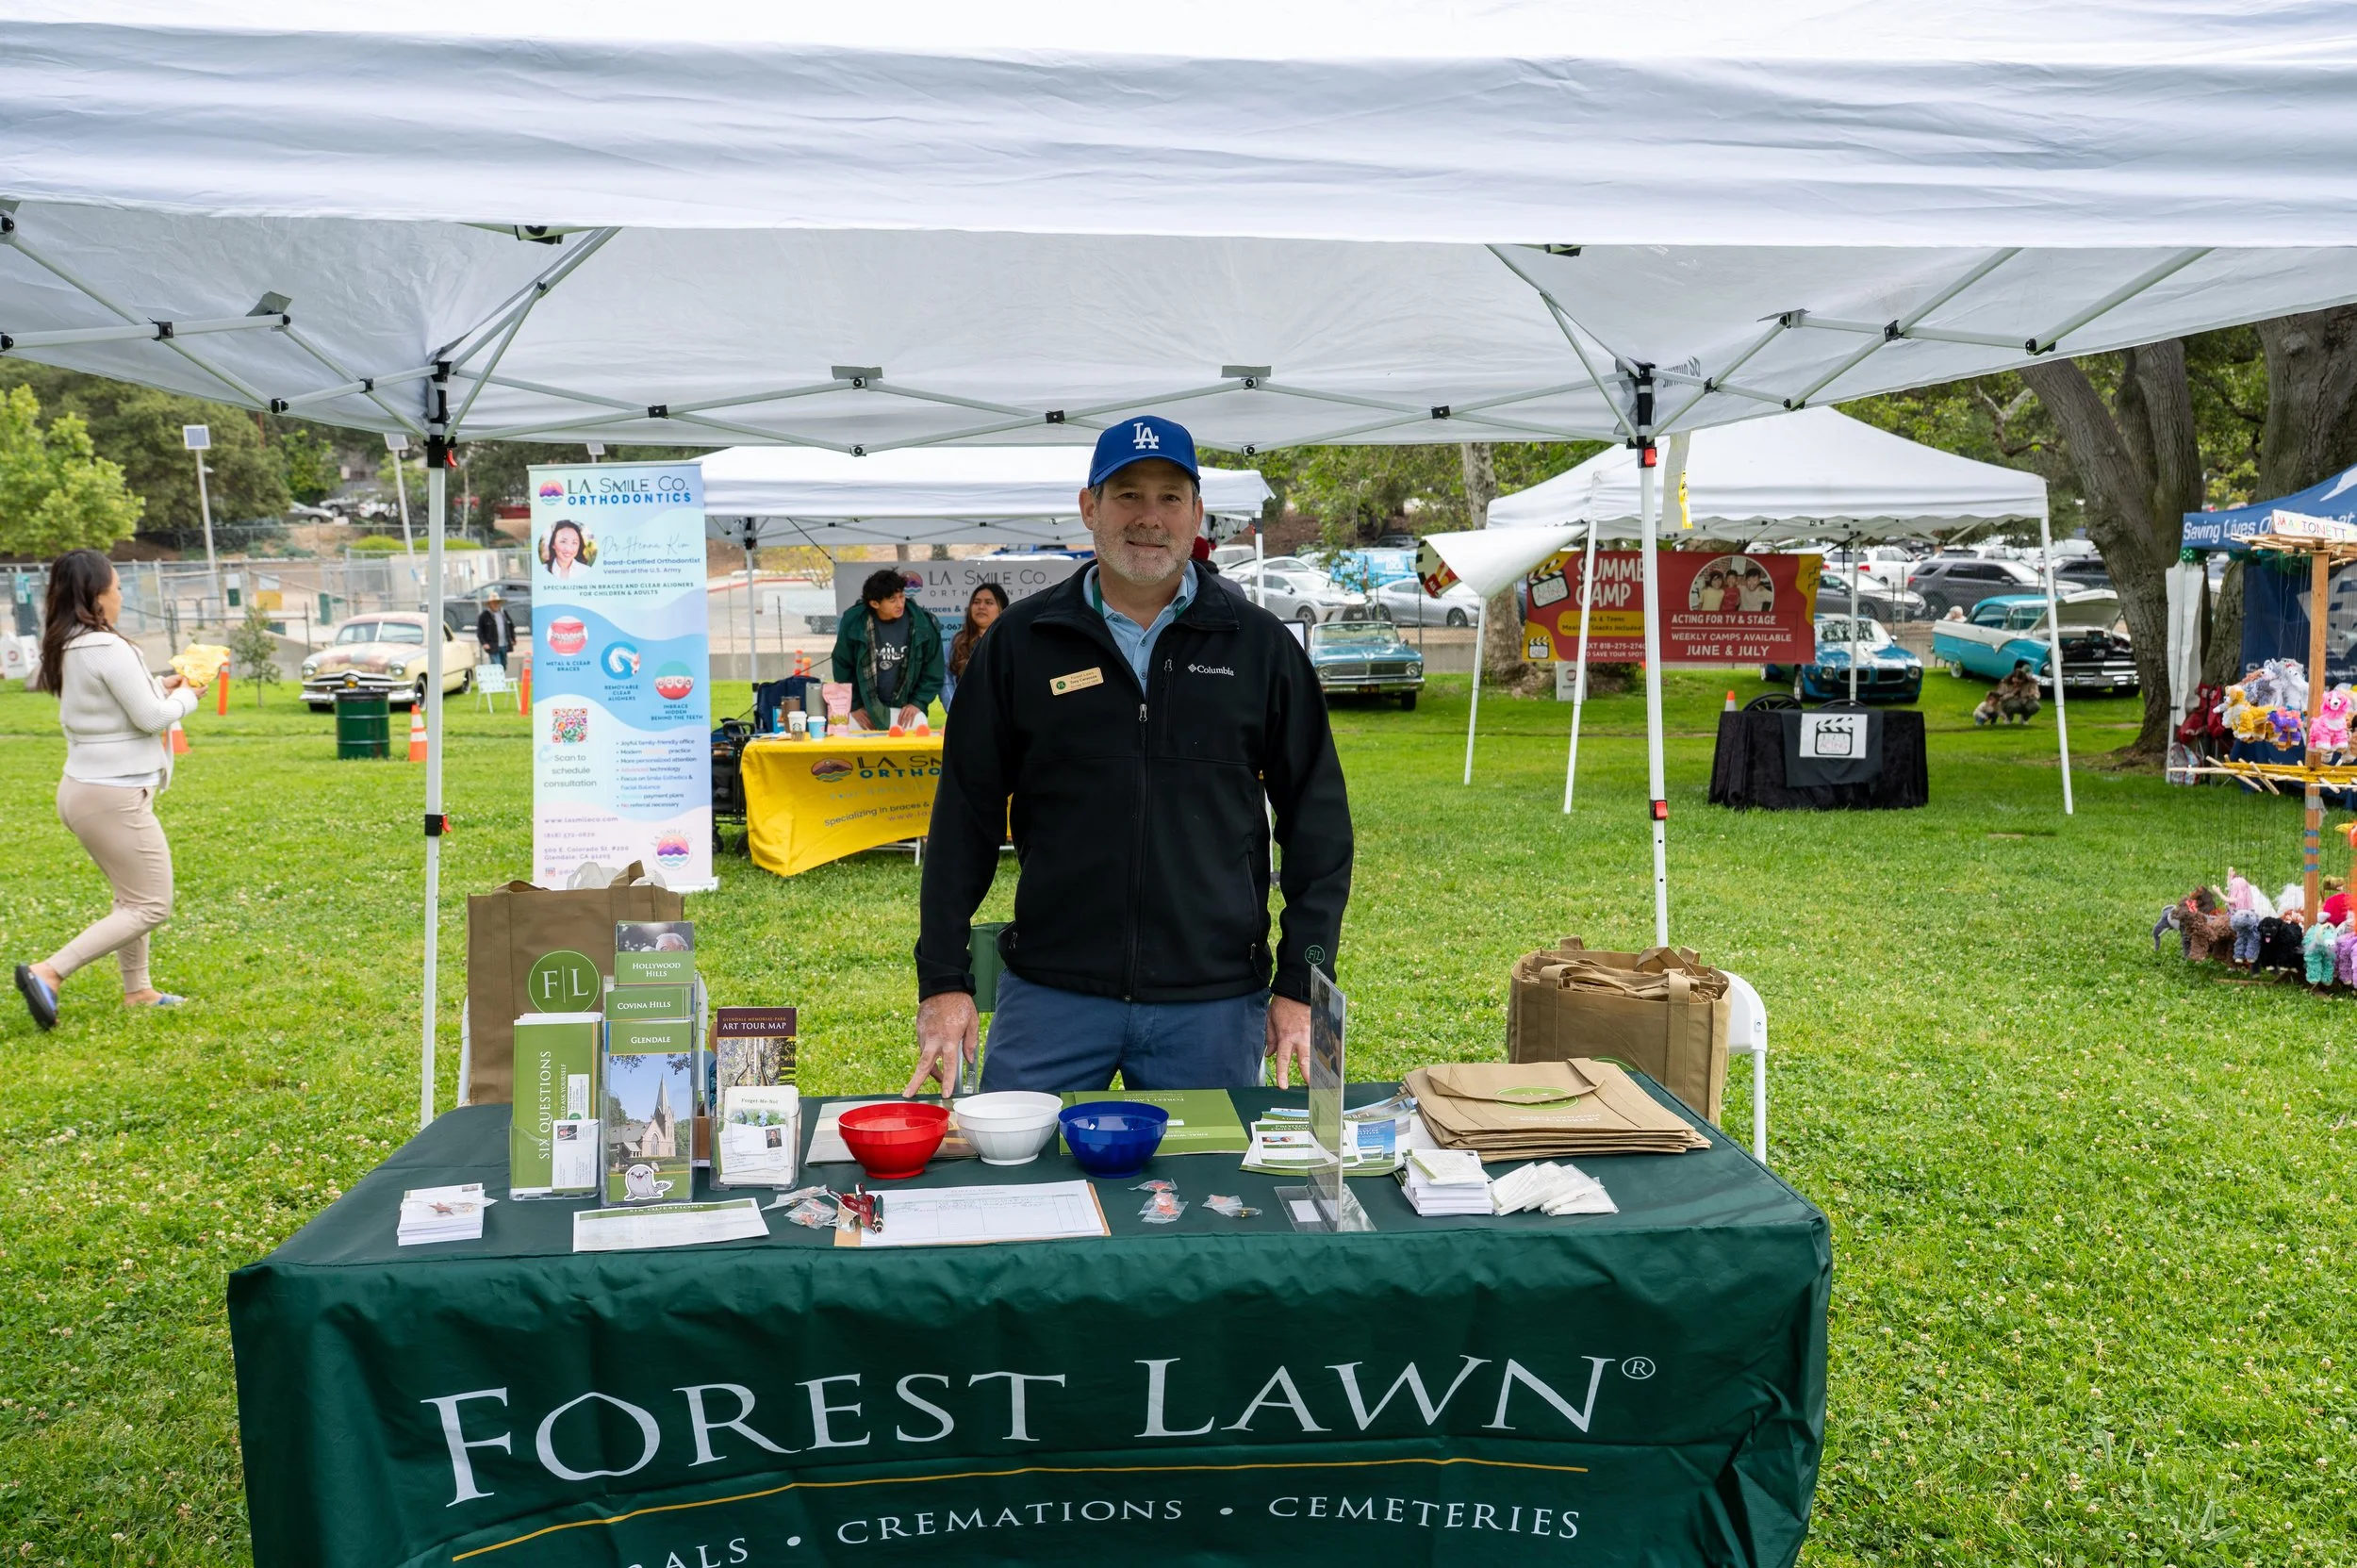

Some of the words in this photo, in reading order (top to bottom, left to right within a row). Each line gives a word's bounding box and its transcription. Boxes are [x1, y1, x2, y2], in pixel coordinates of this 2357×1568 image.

[1132, 422, 1160, 450] LA
[568, 479, 591, 494] LA
[600, 478, 650, 493] SMILE
[568, 492, 691, 506] ORTHODONTICS
[2184, 520, 2220, 544] Saving
[2223, 519, 2256, 538] Lives
[929, 571, 952, 586] LA
[1576, 557, 1644, 583] SUMME
[1671, 615, 1704, 624] ACTING
[1706, 615, 1722, 624] FOR
[1725, 615, 1737, 624] TV
[1738, 615, 1744, 624] &
[1747, 615, 1776, 625] STAGE
[1671, 633, 1707, 641] WEEKLY
[1709, 633, 1741, 641] CAMPS
[1743, 634, 1791, 642] AVAILABLE
[1686, 645, 1720, 656] JUNE
[1725, 645, 1734, 656] &
[1738, 645, 1770, 656] JULY
[1196, 665, 1235, 677] Columbia
[857, 756, 898, 769] LA
[543, 779, 598, 788] consultation
[824, 808, 878, 828] Specializing
[889, 802, 921, 812] braces
[539, 1050, 553, 1133] QUESTIONS
[538, 1138, 550, 1160] SIX
[420, 1370, 1066, 1509] FOREST
[836, 1499, 1184, 1544] CREMATIONS
[1268, 1495, 1580, 1539] CEMETERIES
